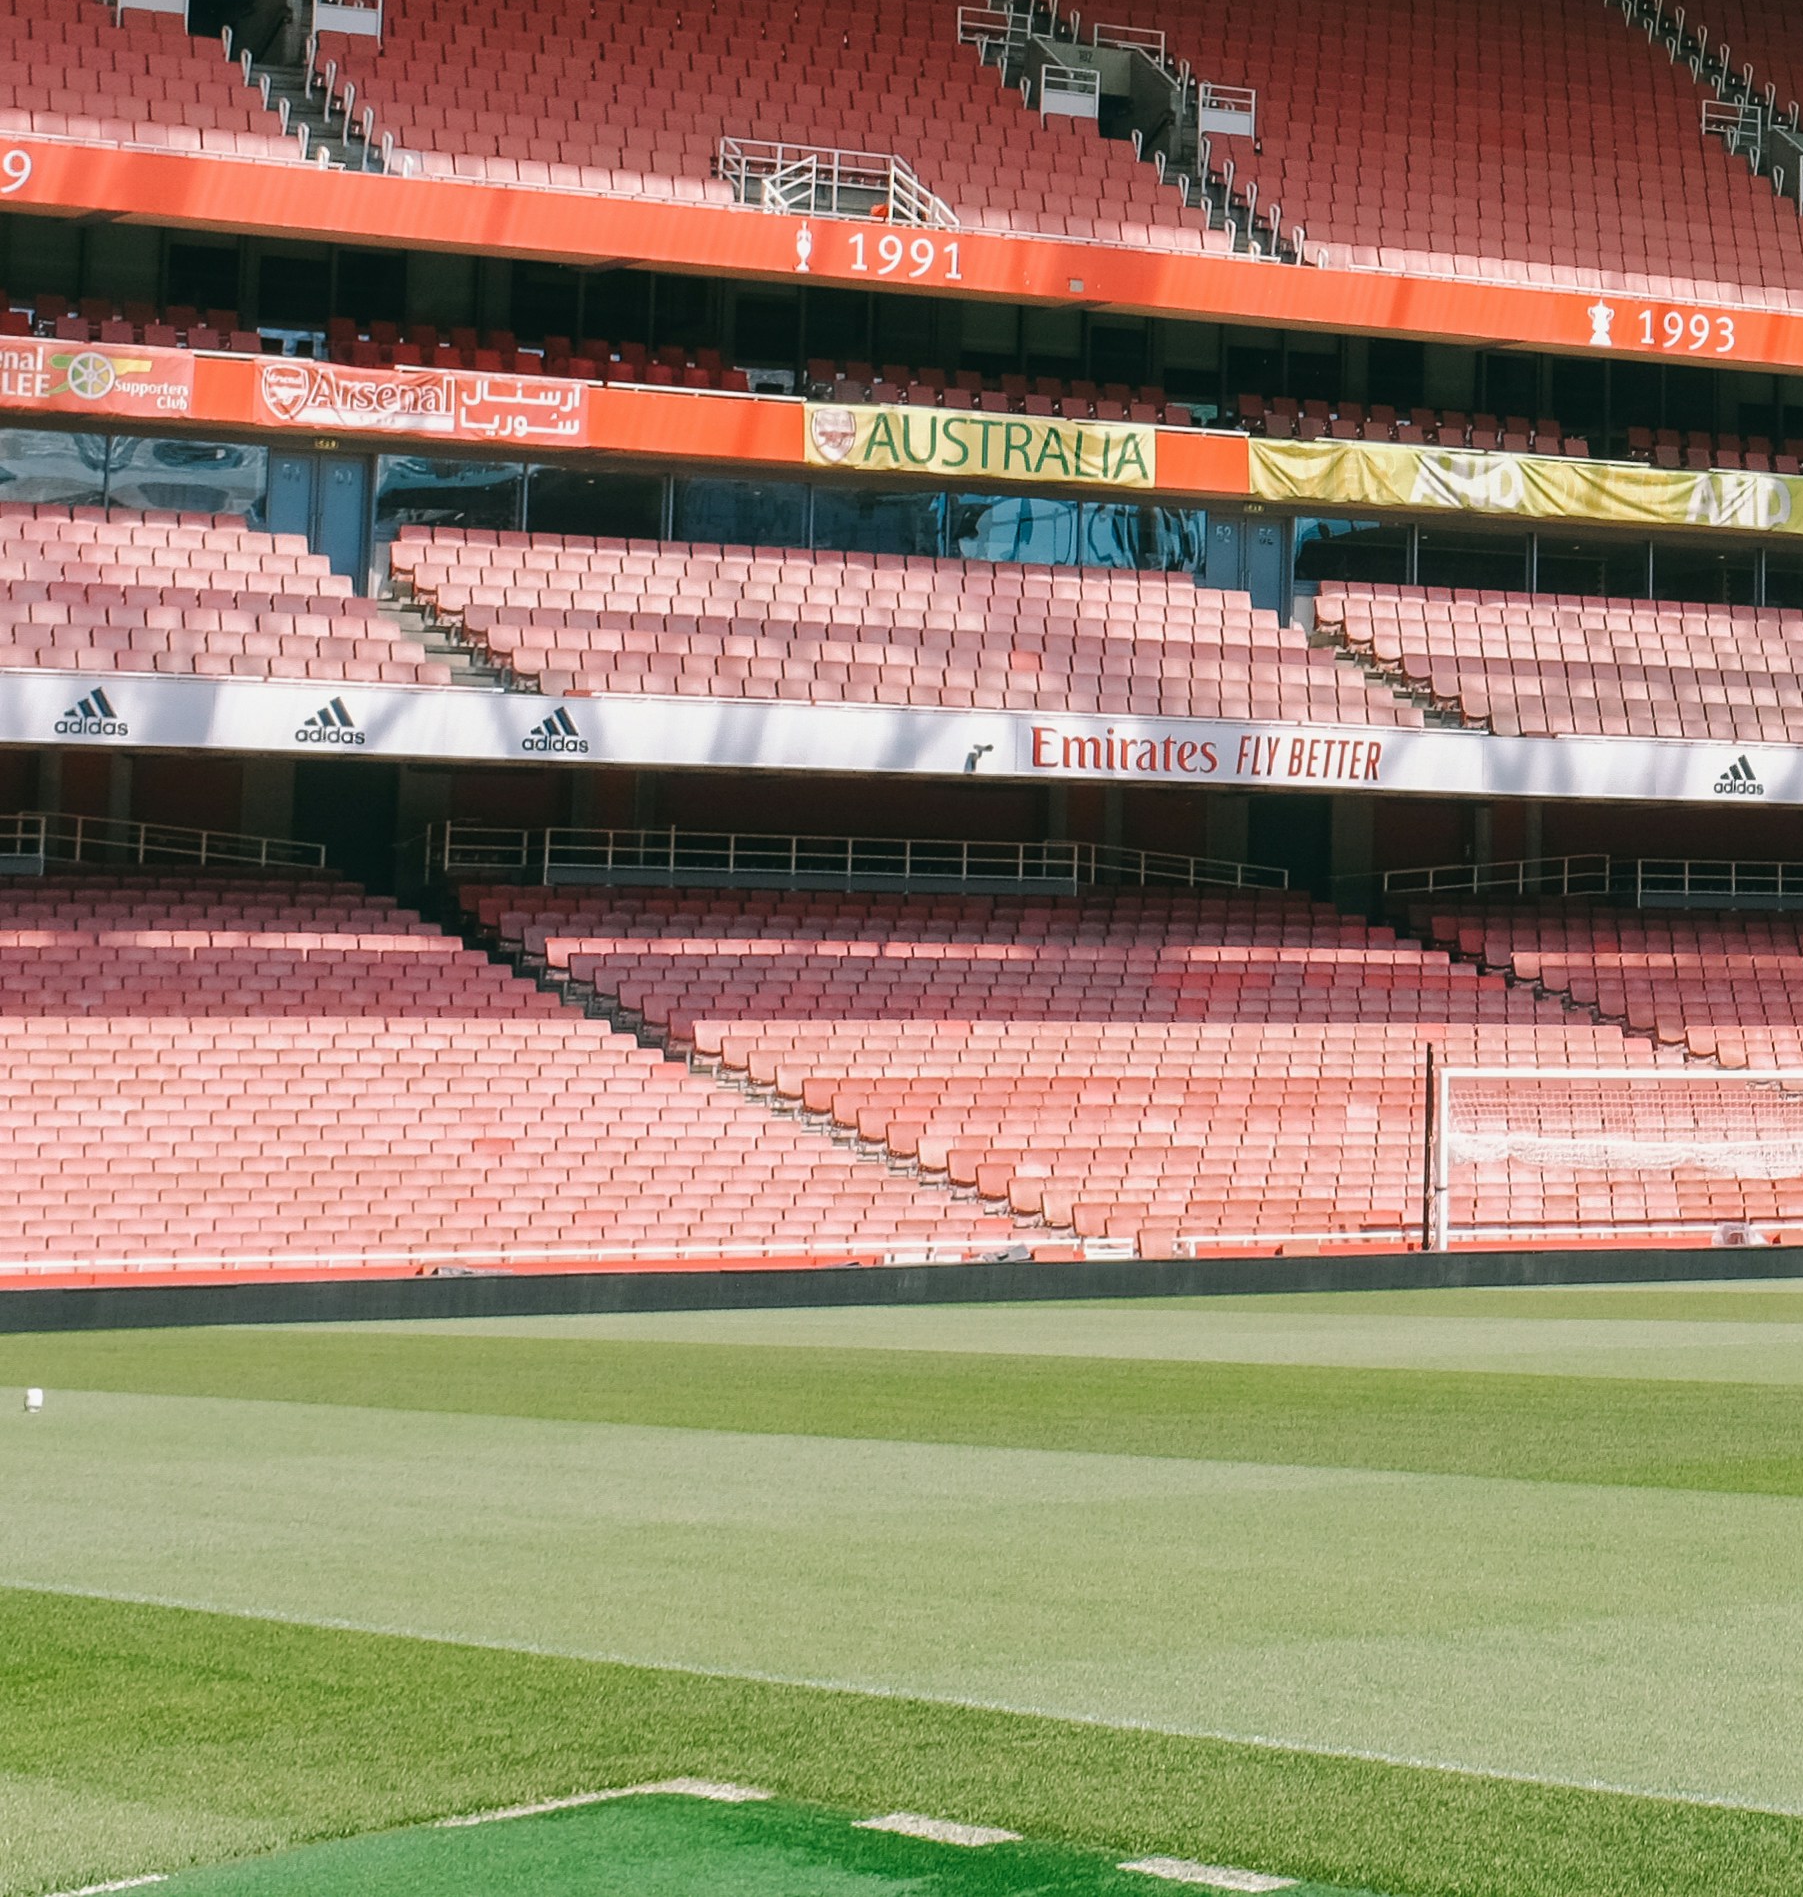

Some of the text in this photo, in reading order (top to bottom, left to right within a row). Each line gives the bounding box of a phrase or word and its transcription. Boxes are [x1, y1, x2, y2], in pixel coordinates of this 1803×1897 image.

[848, 232, 963, 280] 1991
[1638, 310, 1736, 353] 1993
[0, 345, 43, 372] nal
[115, 379, 189, 397] Supporters
[307, 368, 455, 415] Arsenal
[157, 395, 189, 411] Club
[863, 412, 1149, 480] AUSTRALIA
[54, 718, 129, 737] adidas
[295, 726, 365, 745] adidas
[522, 734, 589, 753] adidas
[1031, 726, 1382, 781] Emirates FLY BETTER
[1714, 778, 1764, 795] adidas
